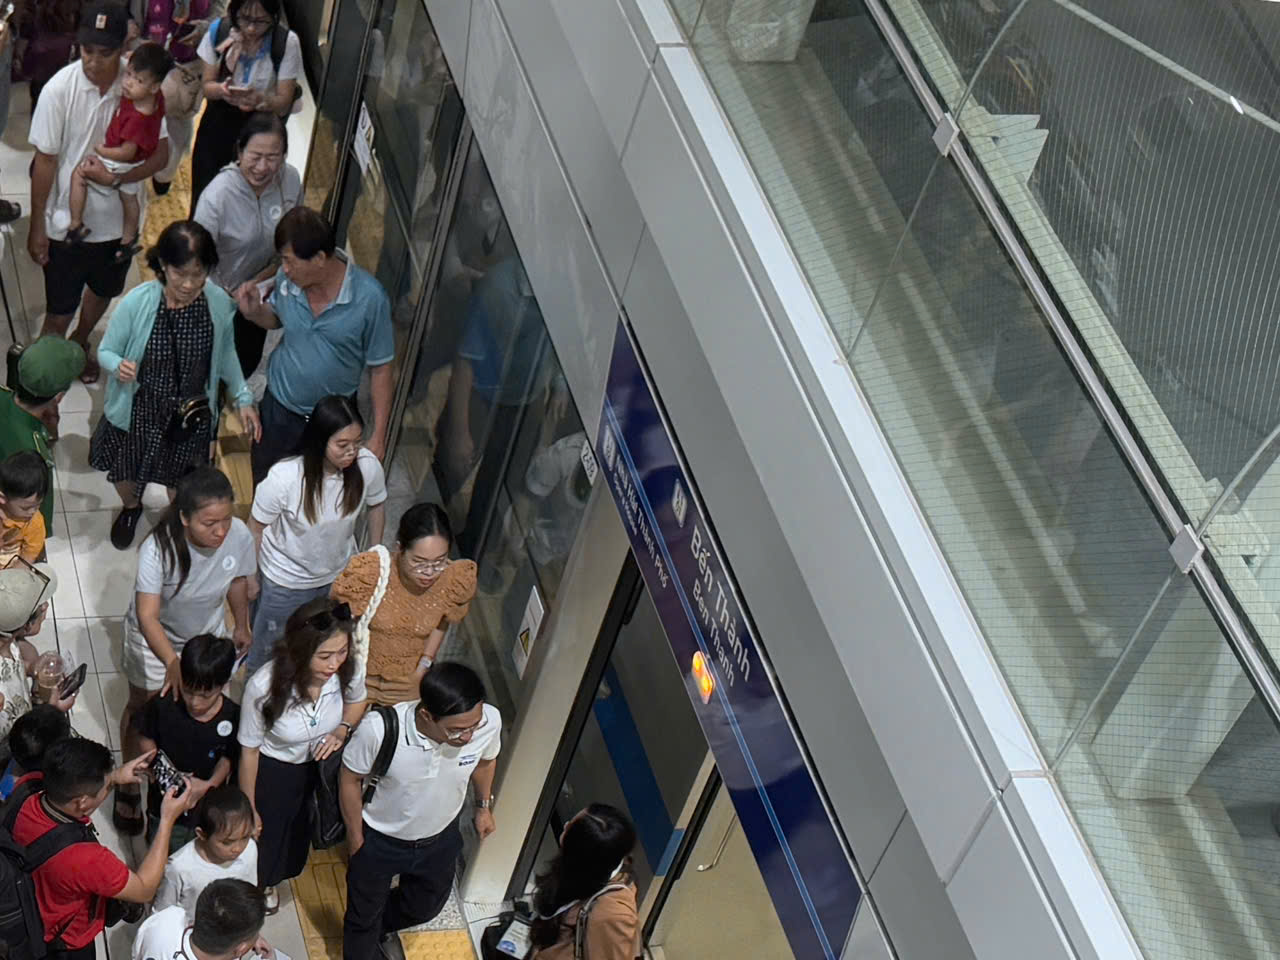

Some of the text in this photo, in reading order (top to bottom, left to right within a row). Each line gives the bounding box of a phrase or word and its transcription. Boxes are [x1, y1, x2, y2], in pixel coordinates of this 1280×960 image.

[690, 524, 750, 682] Bến Thành
[693, 578, 734, 687] Ben Thanh
